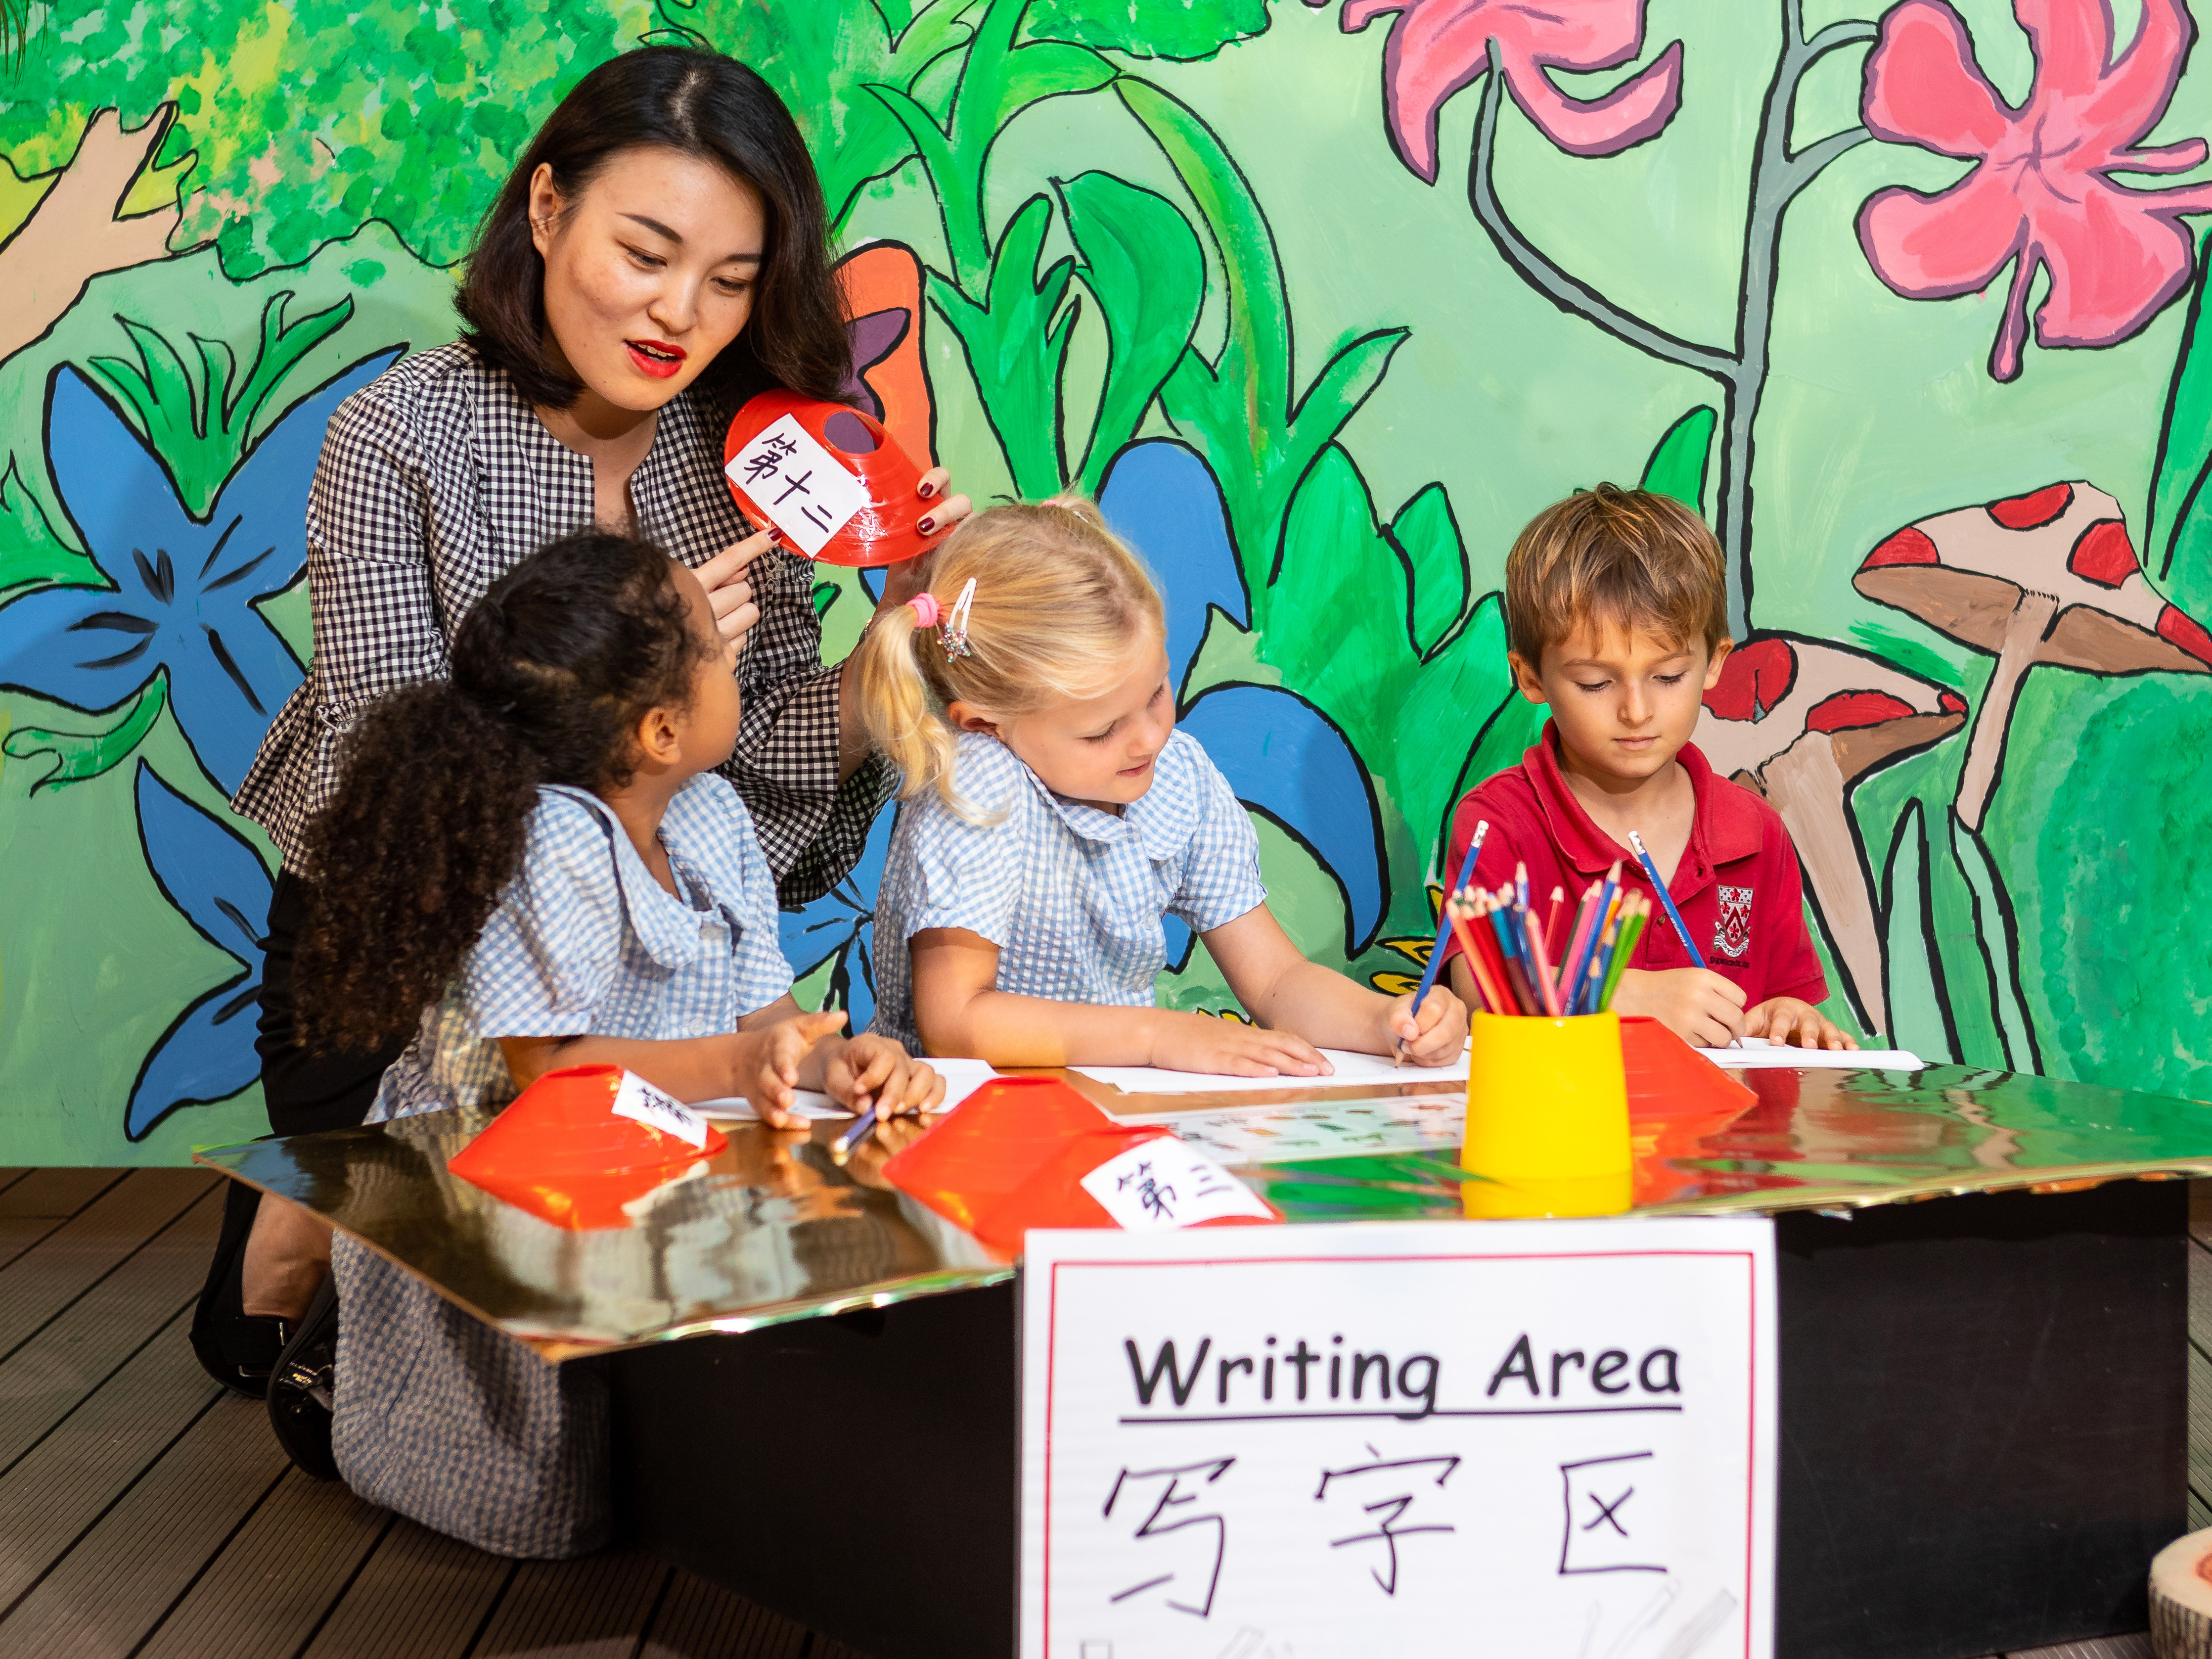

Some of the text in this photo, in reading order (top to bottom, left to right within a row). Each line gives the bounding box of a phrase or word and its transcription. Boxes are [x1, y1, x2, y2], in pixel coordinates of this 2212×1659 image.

[743, 432, 833, 534] 第十二
[1116, 1161, 1234, 1220] 第三
[1124, 1334, 1681, 1421] Writing Area
[1102, 1442, 1668, 1618] 写字区
